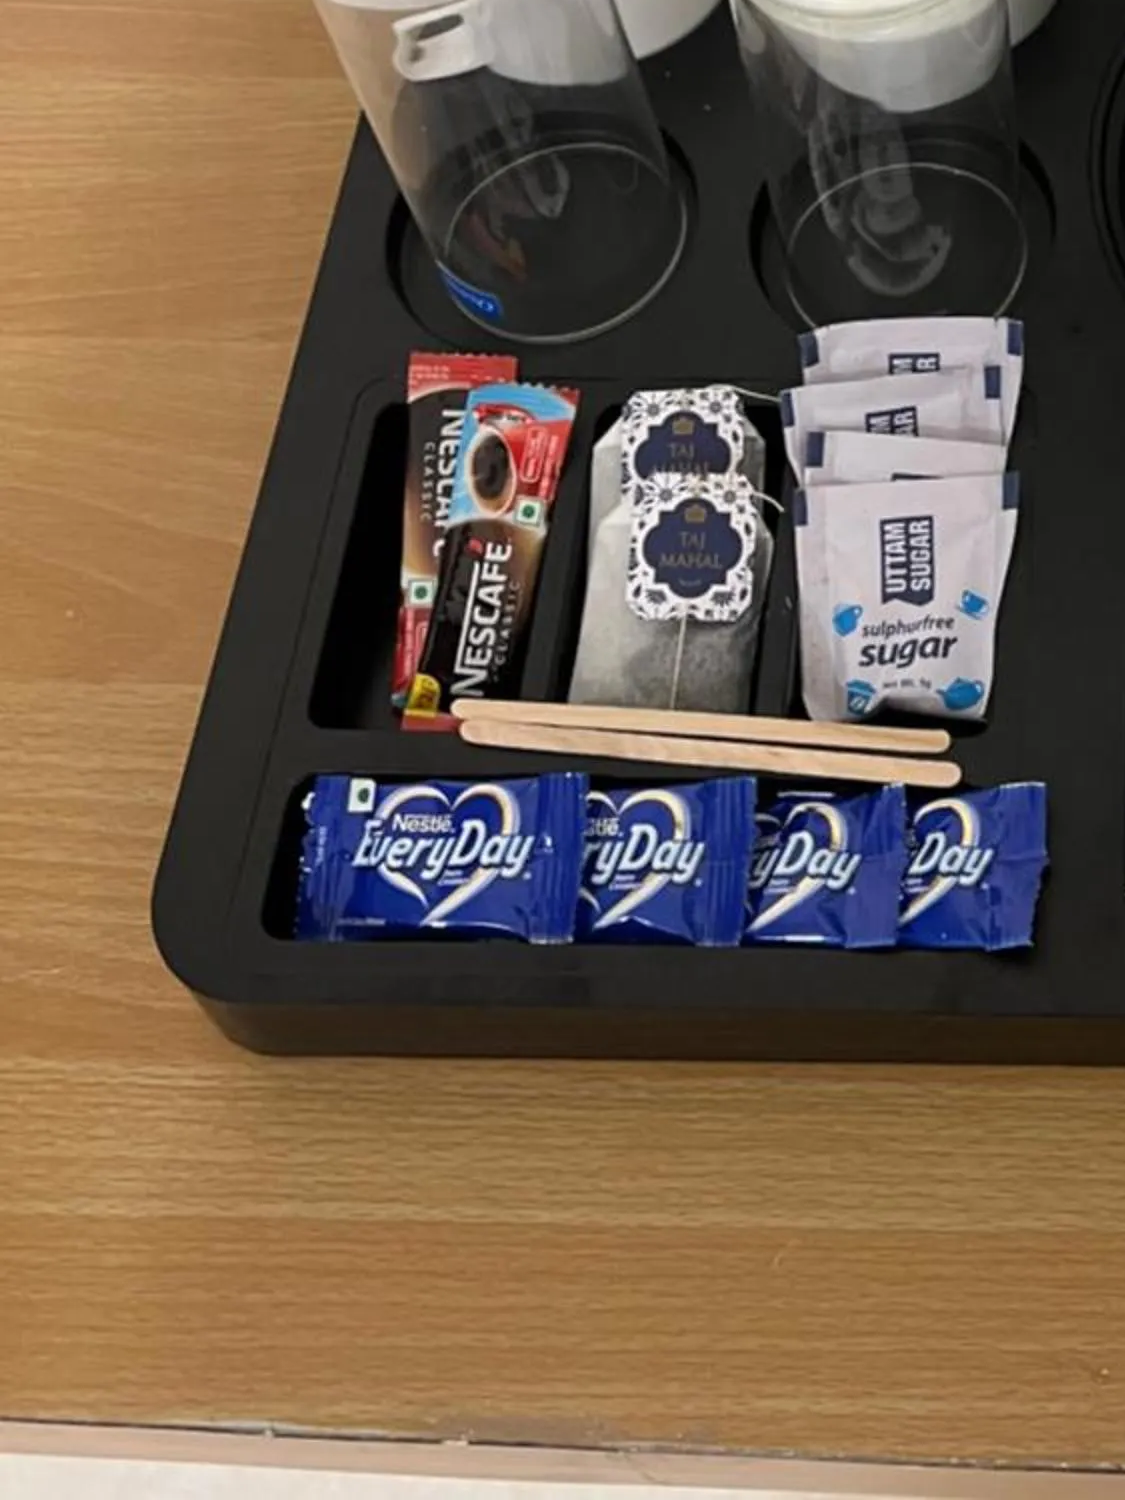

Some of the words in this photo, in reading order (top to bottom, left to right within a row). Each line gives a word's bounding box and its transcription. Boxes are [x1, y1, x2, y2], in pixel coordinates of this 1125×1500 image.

[679, 531, 707, 549] TAJ
[884, 521, 907, 593] UTTAM
[909, 519, 931, 591] SUGAR
[658, 552, 724, 570] MAHAL
[858, 636, 958, 670] sugar
